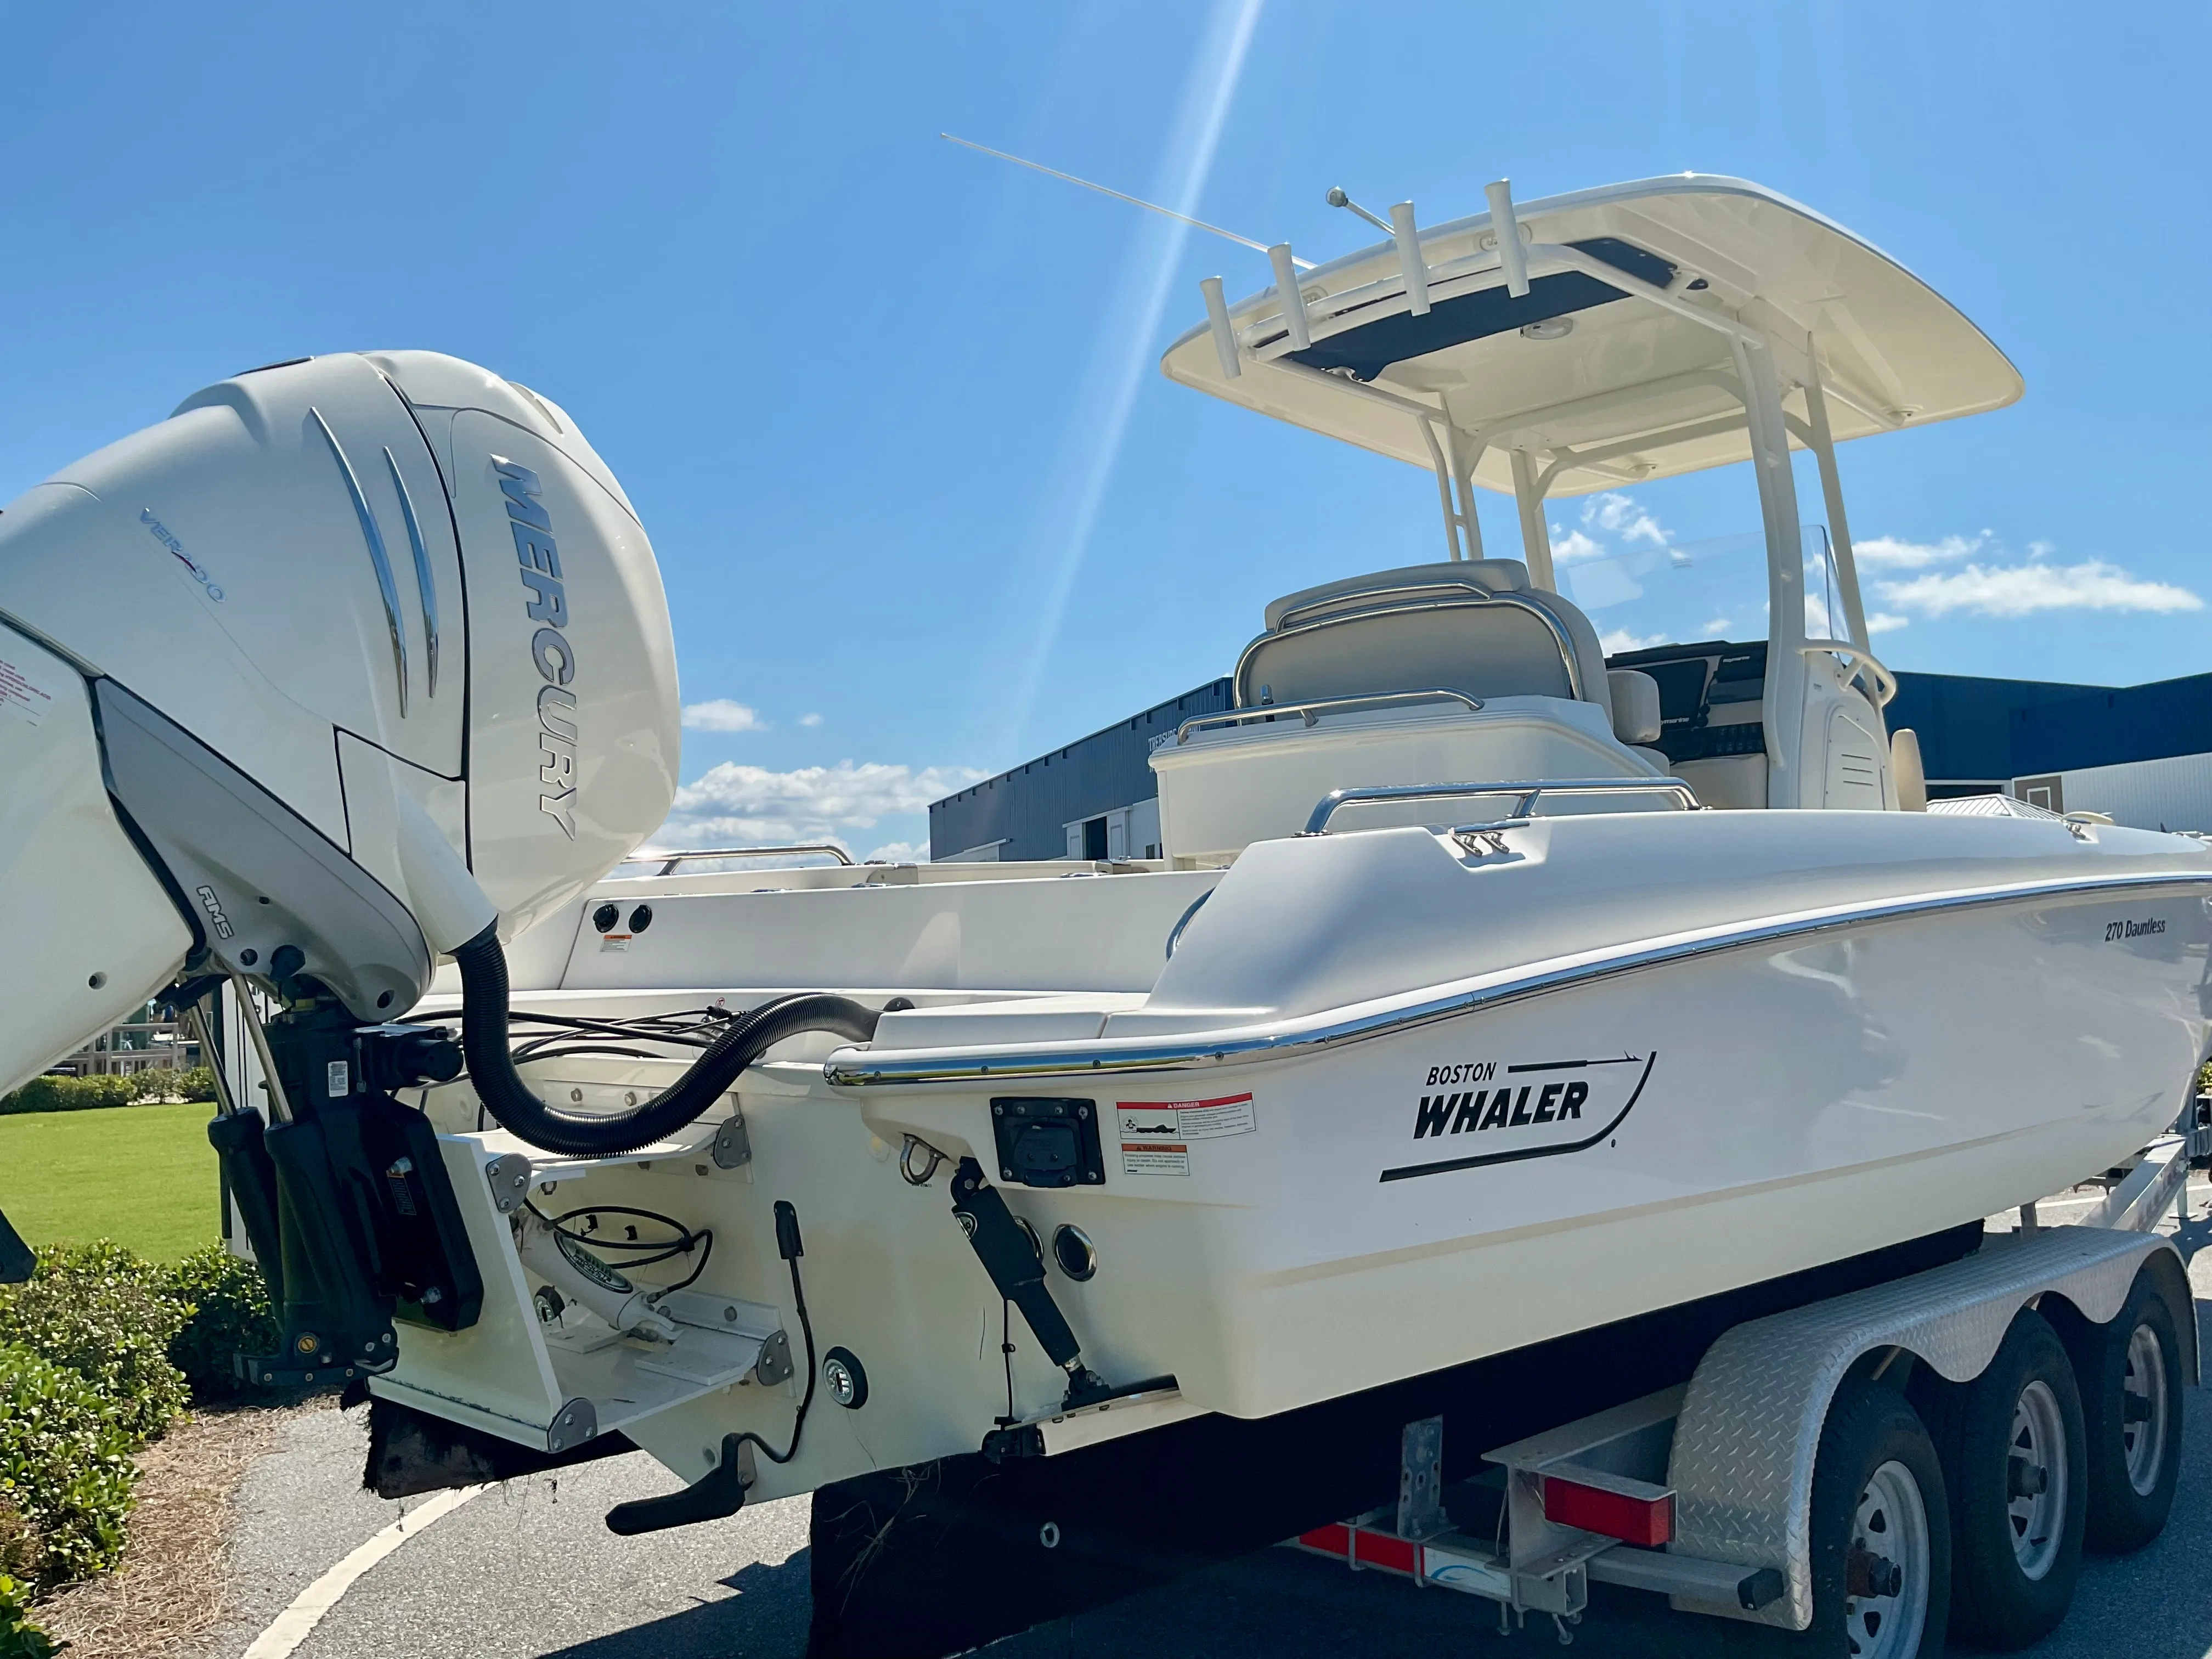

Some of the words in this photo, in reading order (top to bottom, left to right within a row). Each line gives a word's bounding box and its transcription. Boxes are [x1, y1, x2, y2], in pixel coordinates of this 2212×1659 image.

[140, 507, 227, 603] VERADO
[489, 453, 578, 841] MERCURY
[1661, 717, 1690, 725] ymarine
[2104, 922, 2123, 942] 270
[2125, 917, 2165, 938] Dauntless
[1426, 1062, 1497, 1086] BOSTON
[1413, 1081, 1589, 1139] WHALER
